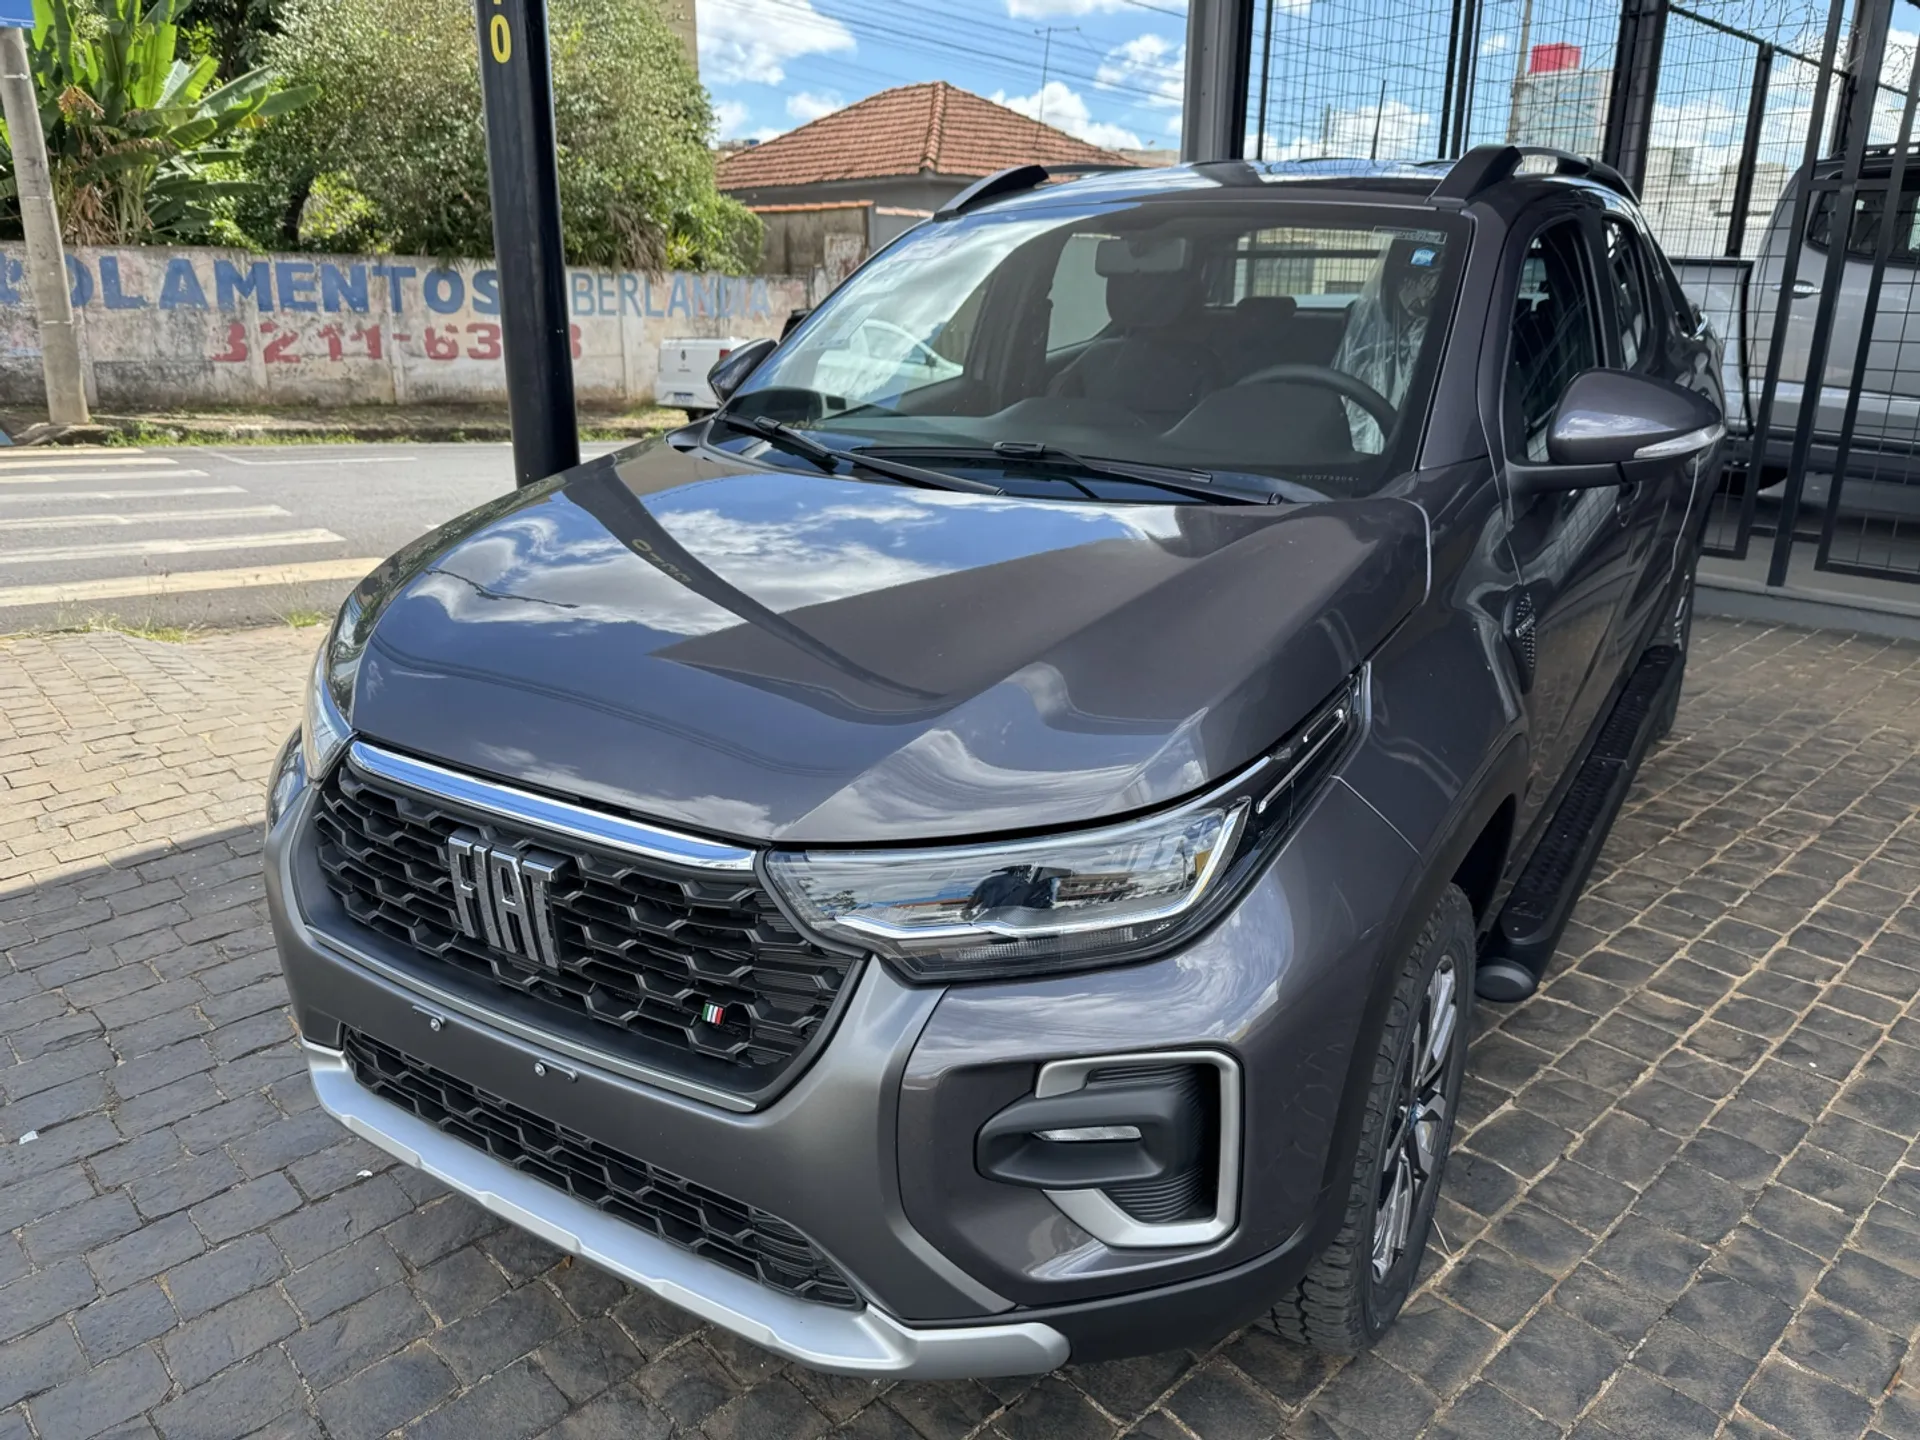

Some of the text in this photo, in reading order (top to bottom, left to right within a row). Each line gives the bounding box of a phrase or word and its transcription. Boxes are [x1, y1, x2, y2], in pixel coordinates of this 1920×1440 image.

[490, 0, 511, 63] 0
[570, 271, 771, 320] BERLANDIA
[211, 321, 582, 364] 3211-63
[448, 836, 560, 969] FIAT
